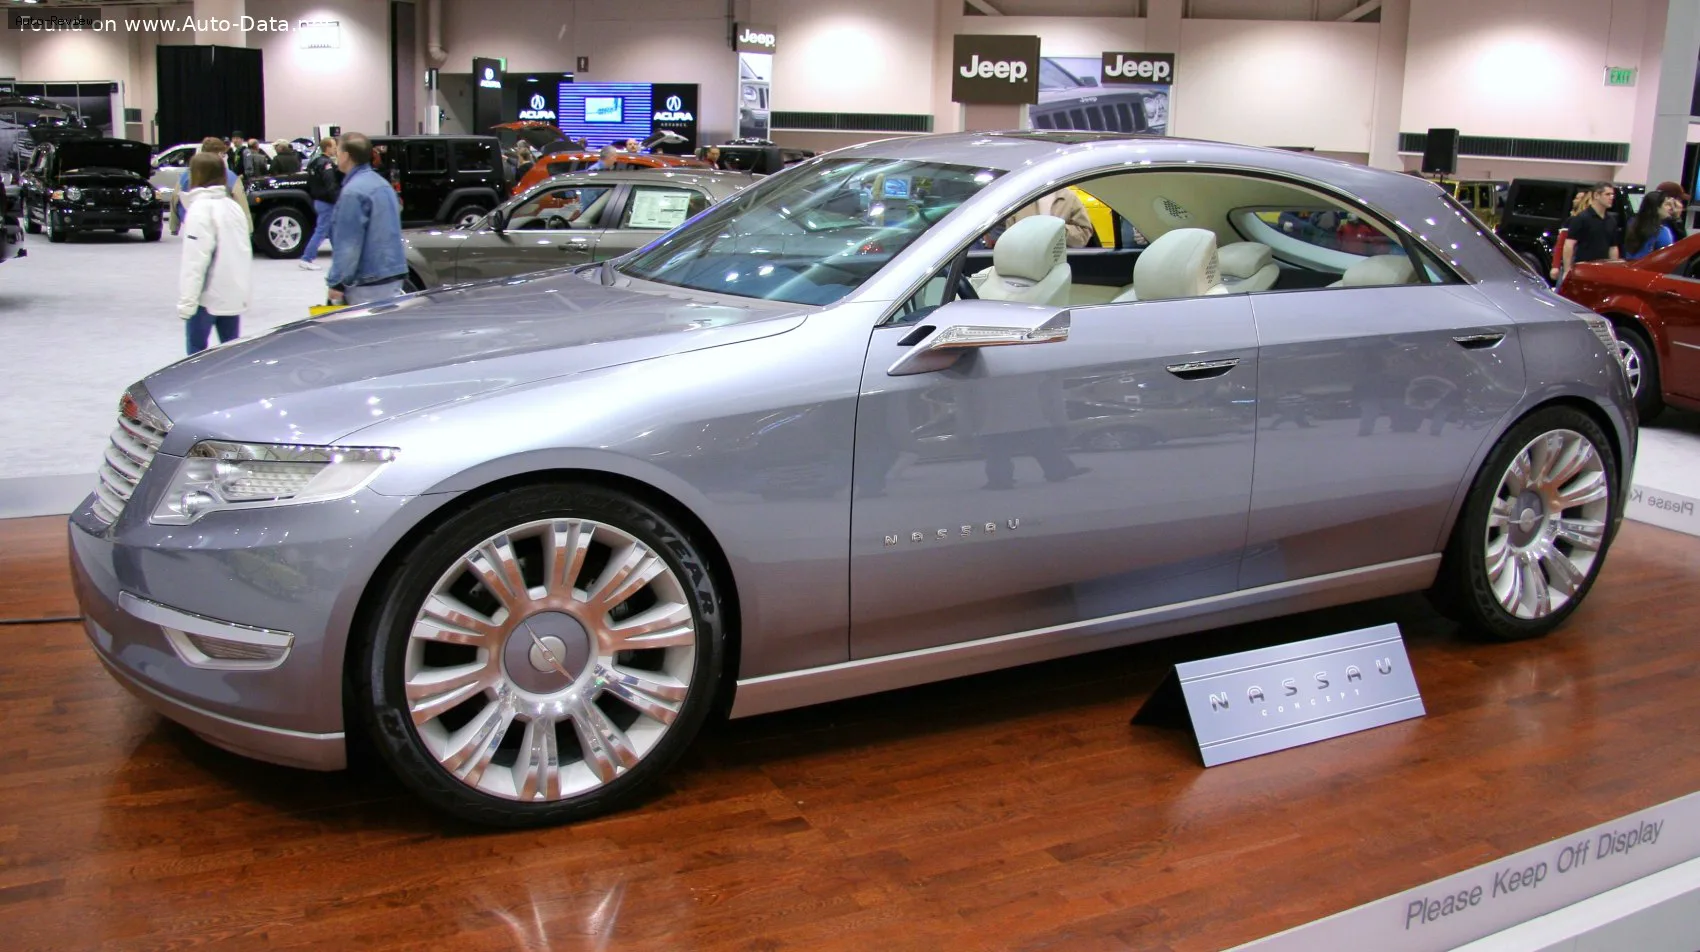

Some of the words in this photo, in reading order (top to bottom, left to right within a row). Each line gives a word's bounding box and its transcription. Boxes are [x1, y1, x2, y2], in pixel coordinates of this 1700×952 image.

[740, 29, 775, 47] Jeep
[960, 54, 1027, 83] Jeep
[1105, 54, 1170, 81] Jeep
[1610, 71, 1632, 84] EXIT
[519, 110, 556, 119] ACURA
[653, 111, 693, 121] ACURA
[884, 518, 1020, 547] NASSAU
[1209, 657, 1392, 711] NASSAU
[1261, 688, 1361, 716] CONCEPT
[1405, 884, 1483, 930] Please
[1492, 860, 1547, 898] Keep
[1556, 840, 1590, 873] Off
[1596, 818, 1665, 860] Display
